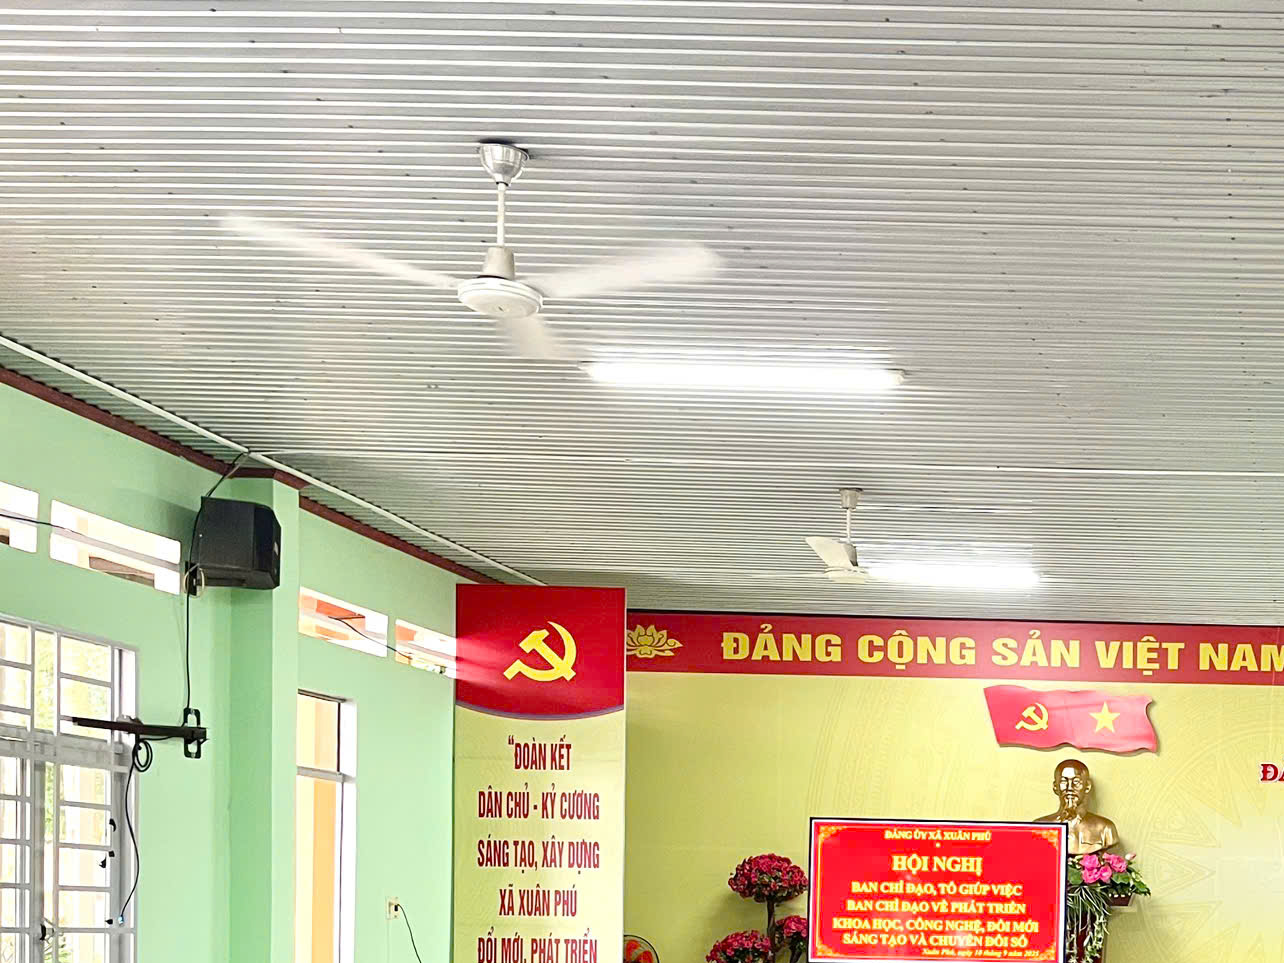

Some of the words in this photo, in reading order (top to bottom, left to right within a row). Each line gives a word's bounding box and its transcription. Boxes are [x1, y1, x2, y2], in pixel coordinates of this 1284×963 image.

[721, 624, 842, 662] ĐẢNG
[857, 629, 976, 669] CỘNG
[991, 629, 1080, 667] SẢN
[1094, 636, 1185, 676] VIỆT
[550, 734, 572, 770] KẾT
[478, 785, 503, 818] DÂN
[506, 782, 530, 819] CHỦ
[541, 783, 557, 819] KỶ
[560, 789, 600, 820] CƯƠNG
[477, 834, 509, 867] SÁNG
[513, 840, 538, 874] TẠO,
[541, 835, 564, 868] XÂY
[567, 839, 600, 874] DỰNG
[892, 854, 929, 875] HỘI
[932, 855, 983, 876] NGHỊ
[499, 884, 515, 916] XÃ
[518, 883, 550, 916] XUÂN
[554, 884, 577, 917] PHÚ
[851, 881, 878, 893] BAN
[959, 881, 991, 895] GIÚP
[991, 883, 1023, 898] VIỆC
[847, 899, 873, 911] BAN
[901, 901, 929, 914] ĐẠO
[950, 899, 985, 913] PHÁT
[832, 917, 871, 929] KHOA
[905, 917, 943, 931] CÔNG
[842, 931, 878, 945] SÁNG
[880, 933, 907, 948] TẠO
[909, 932, 928, 946] VÀ
